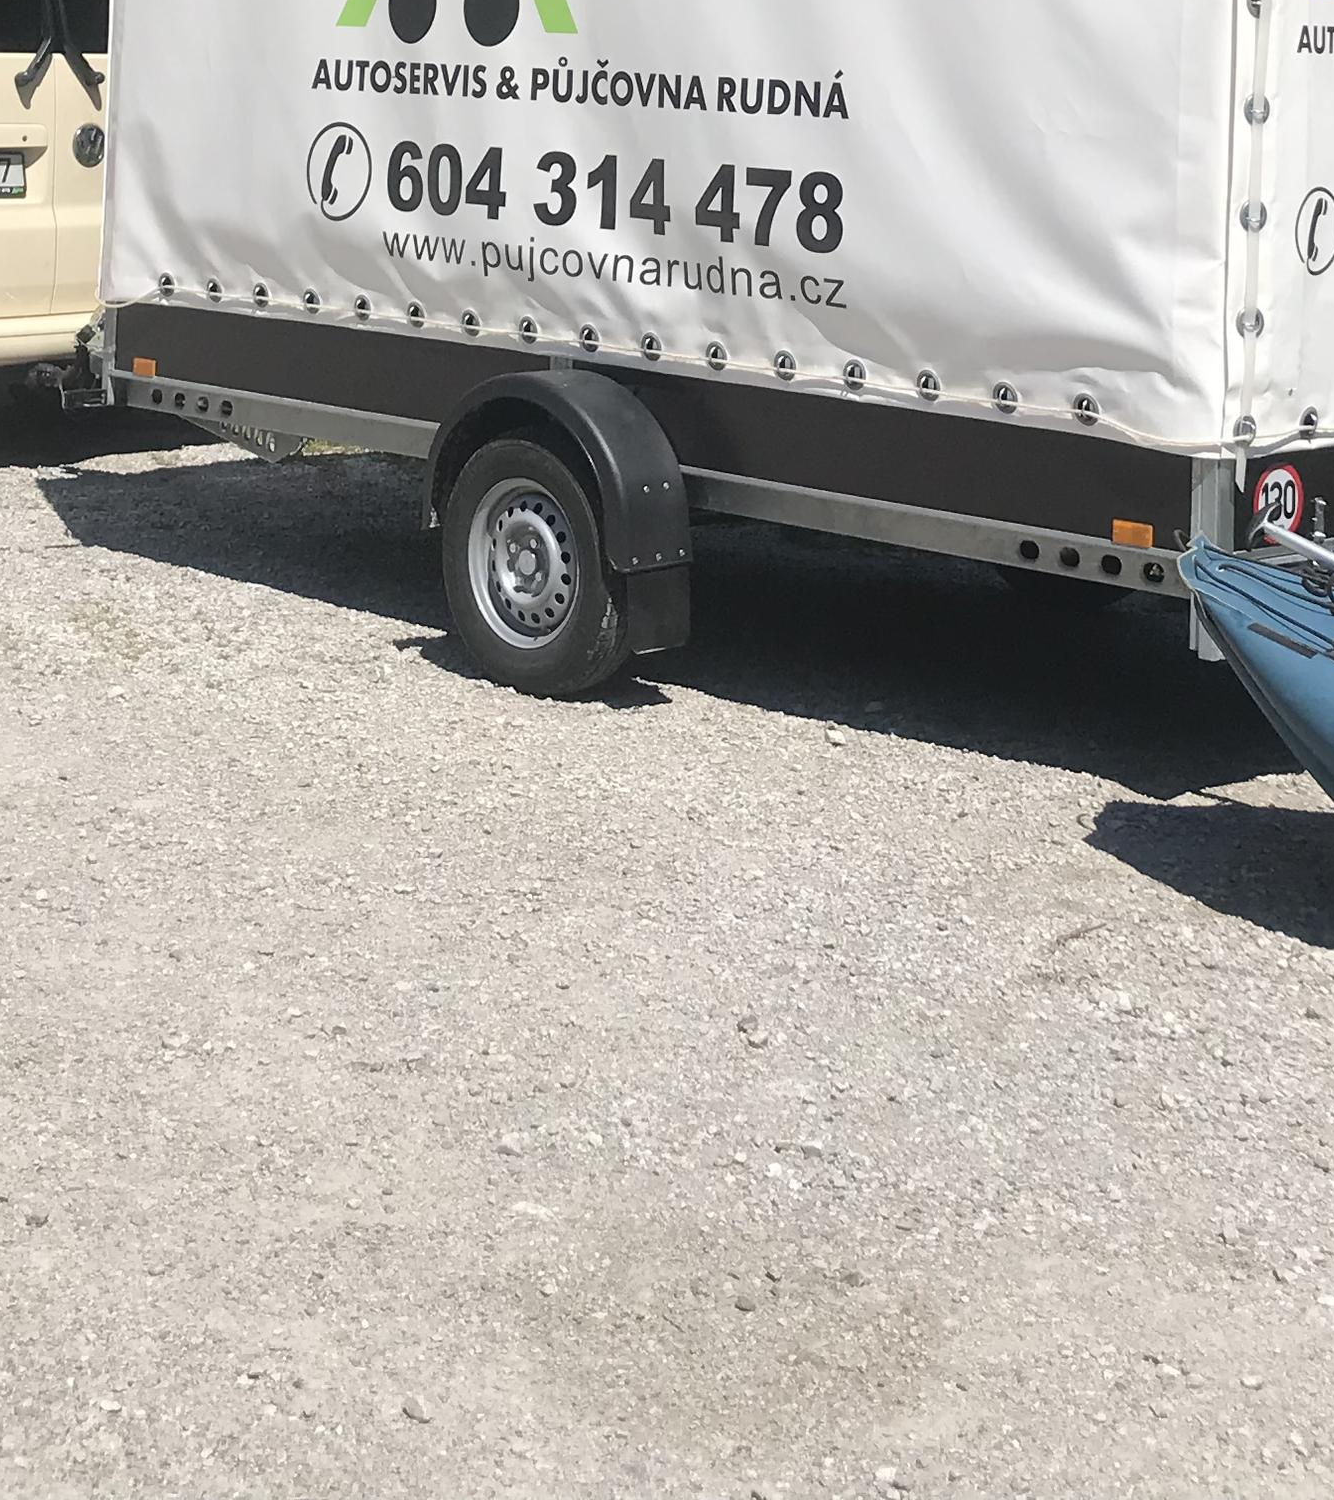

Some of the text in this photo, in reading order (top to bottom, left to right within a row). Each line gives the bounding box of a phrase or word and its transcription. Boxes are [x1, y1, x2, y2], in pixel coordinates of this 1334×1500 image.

[311, 56, 849, 120] AUTOSERVIS & PŮJČOVNA RUDNÁ
[386, 140, 844, 254] 604 314 478
[382, 230, 848, 309] www.pujcovnarudna.cz
